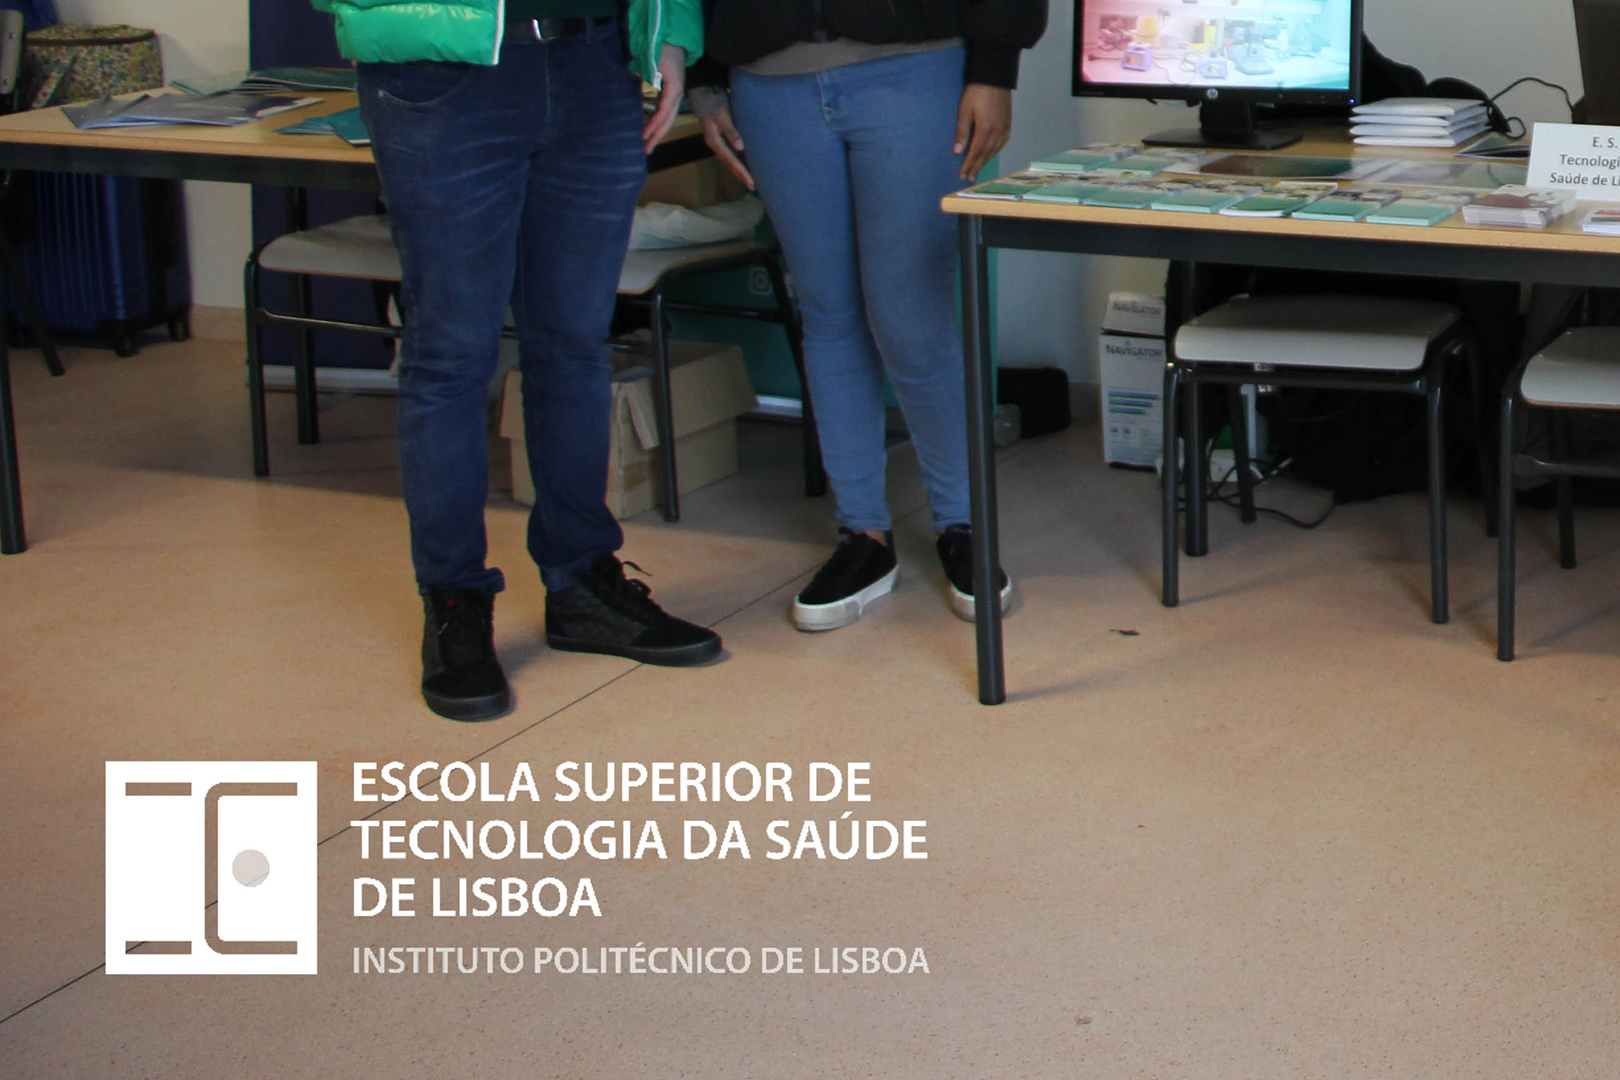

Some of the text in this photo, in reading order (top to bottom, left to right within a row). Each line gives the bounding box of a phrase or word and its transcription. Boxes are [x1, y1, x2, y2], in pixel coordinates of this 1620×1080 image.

[1592, 136, 1618, 148] E. S.
[1550, 172, 1588, 185] Saúde
[1592, 174, 1608, 186] de
[1113, 301, 1161, 315] NAVIGATOR
[1105, 344, 1162, 357] NAVIGATOR
